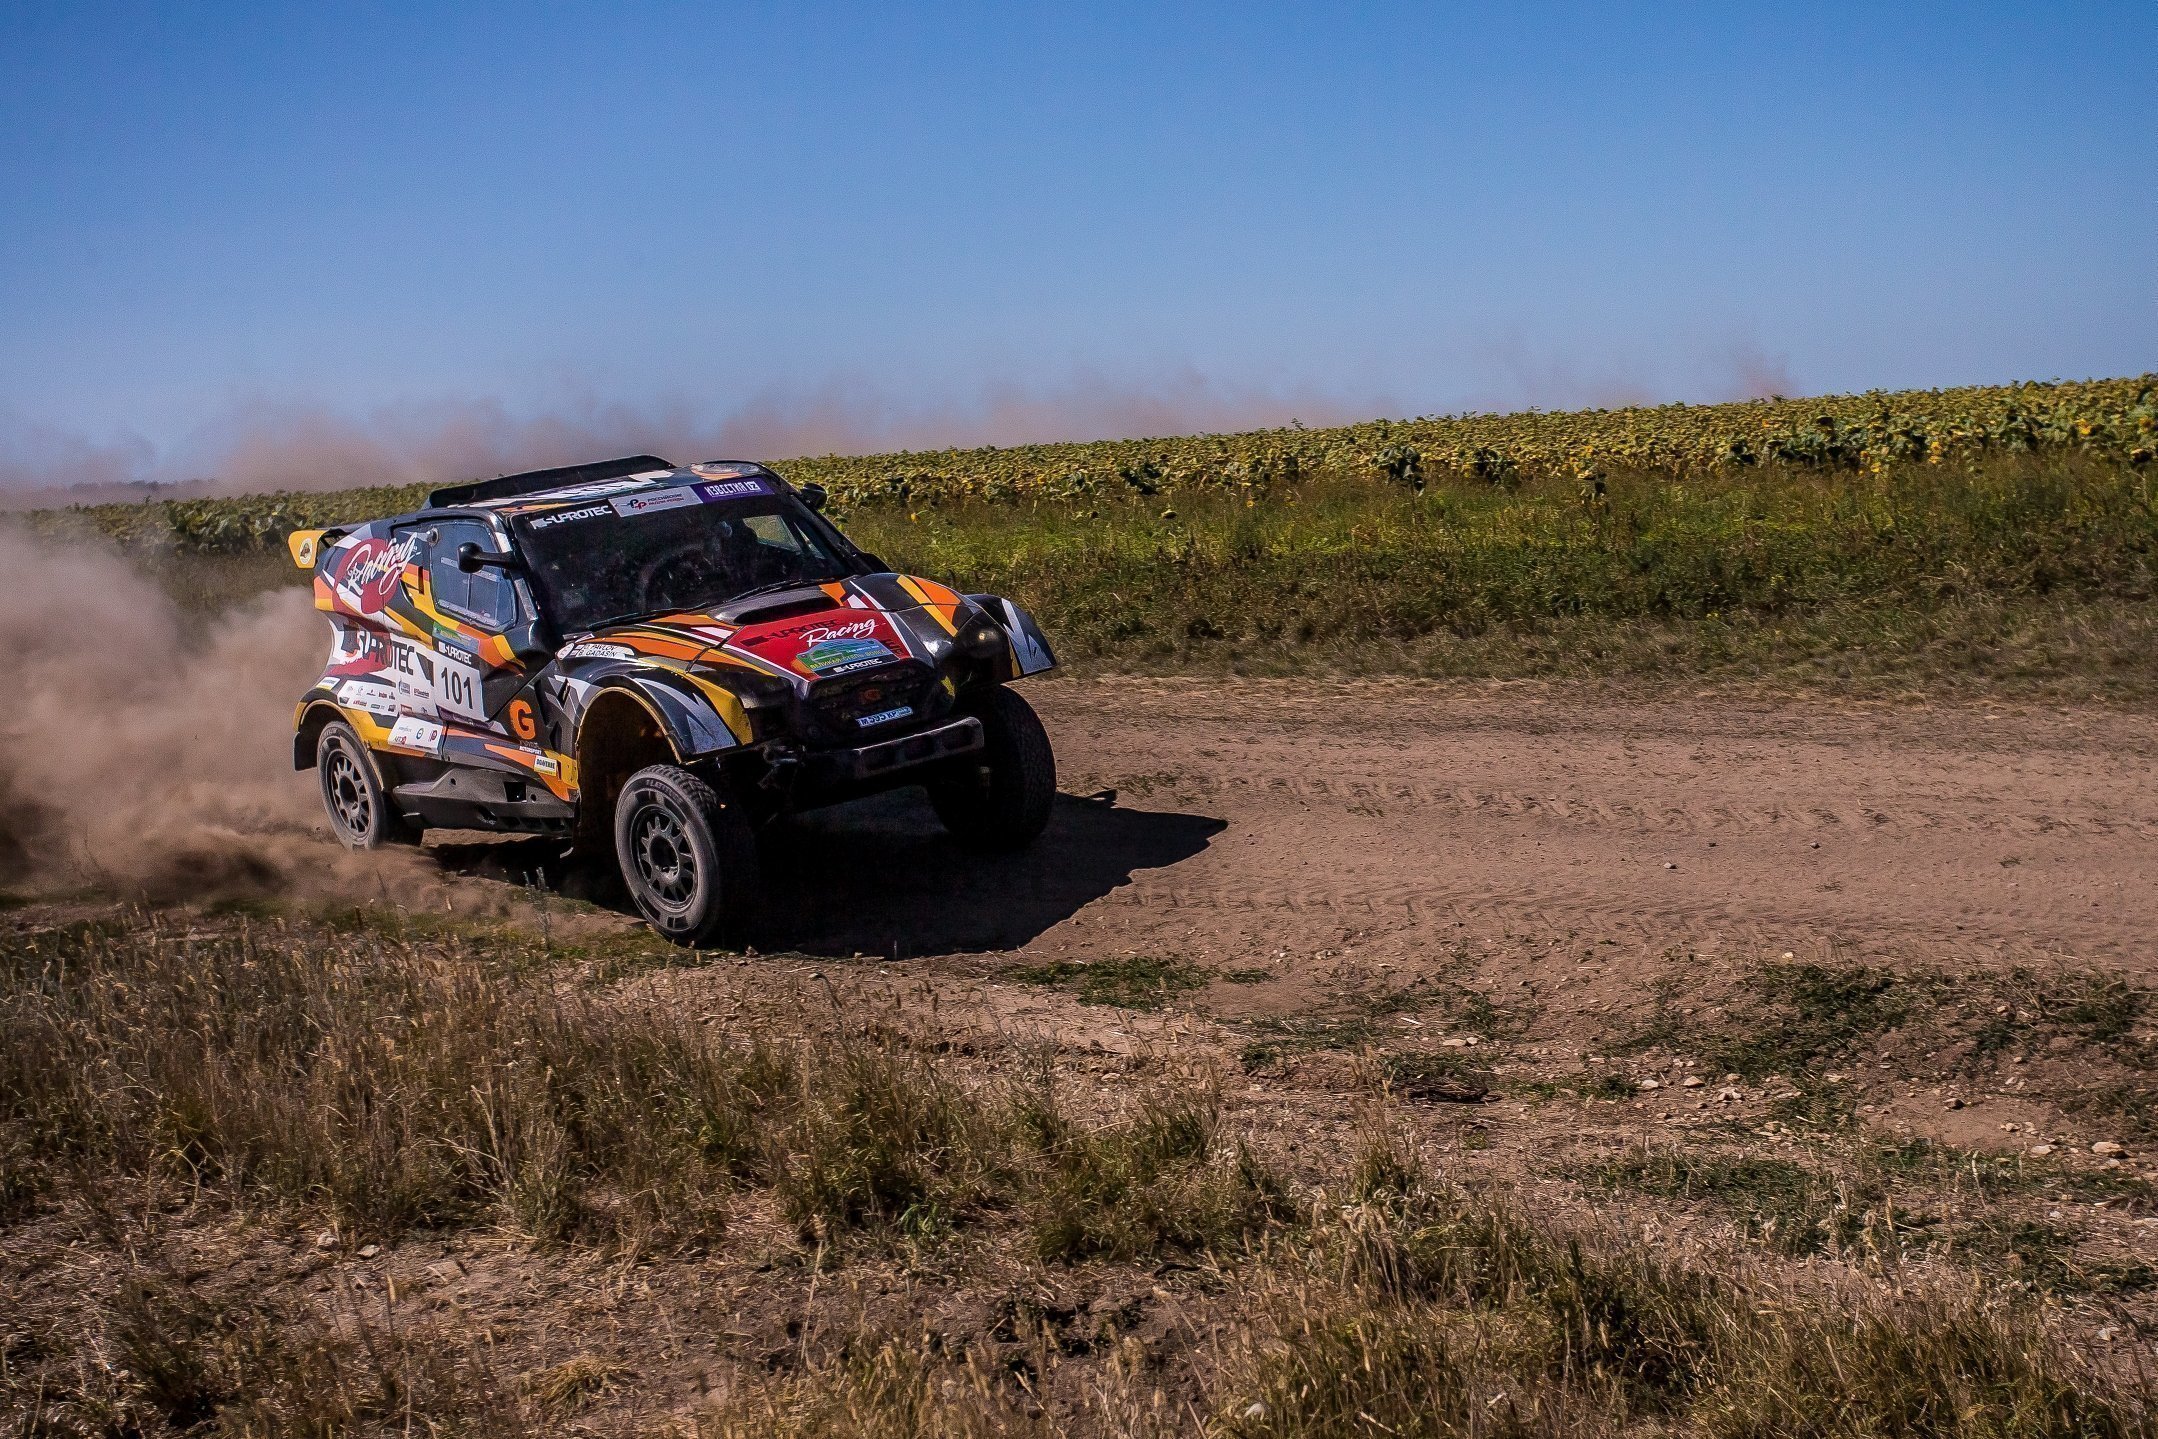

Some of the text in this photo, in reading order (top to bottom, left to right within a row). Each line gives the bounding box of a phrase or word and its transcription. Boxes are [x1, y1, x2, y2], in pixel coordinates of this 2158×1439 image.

[704, 482, 746, 497] ИЗВЕСТИЯ
[799, 618, 881, 648] Racing
[441, 667, 473, 709] 101
[509, 699, 536, 740] G
